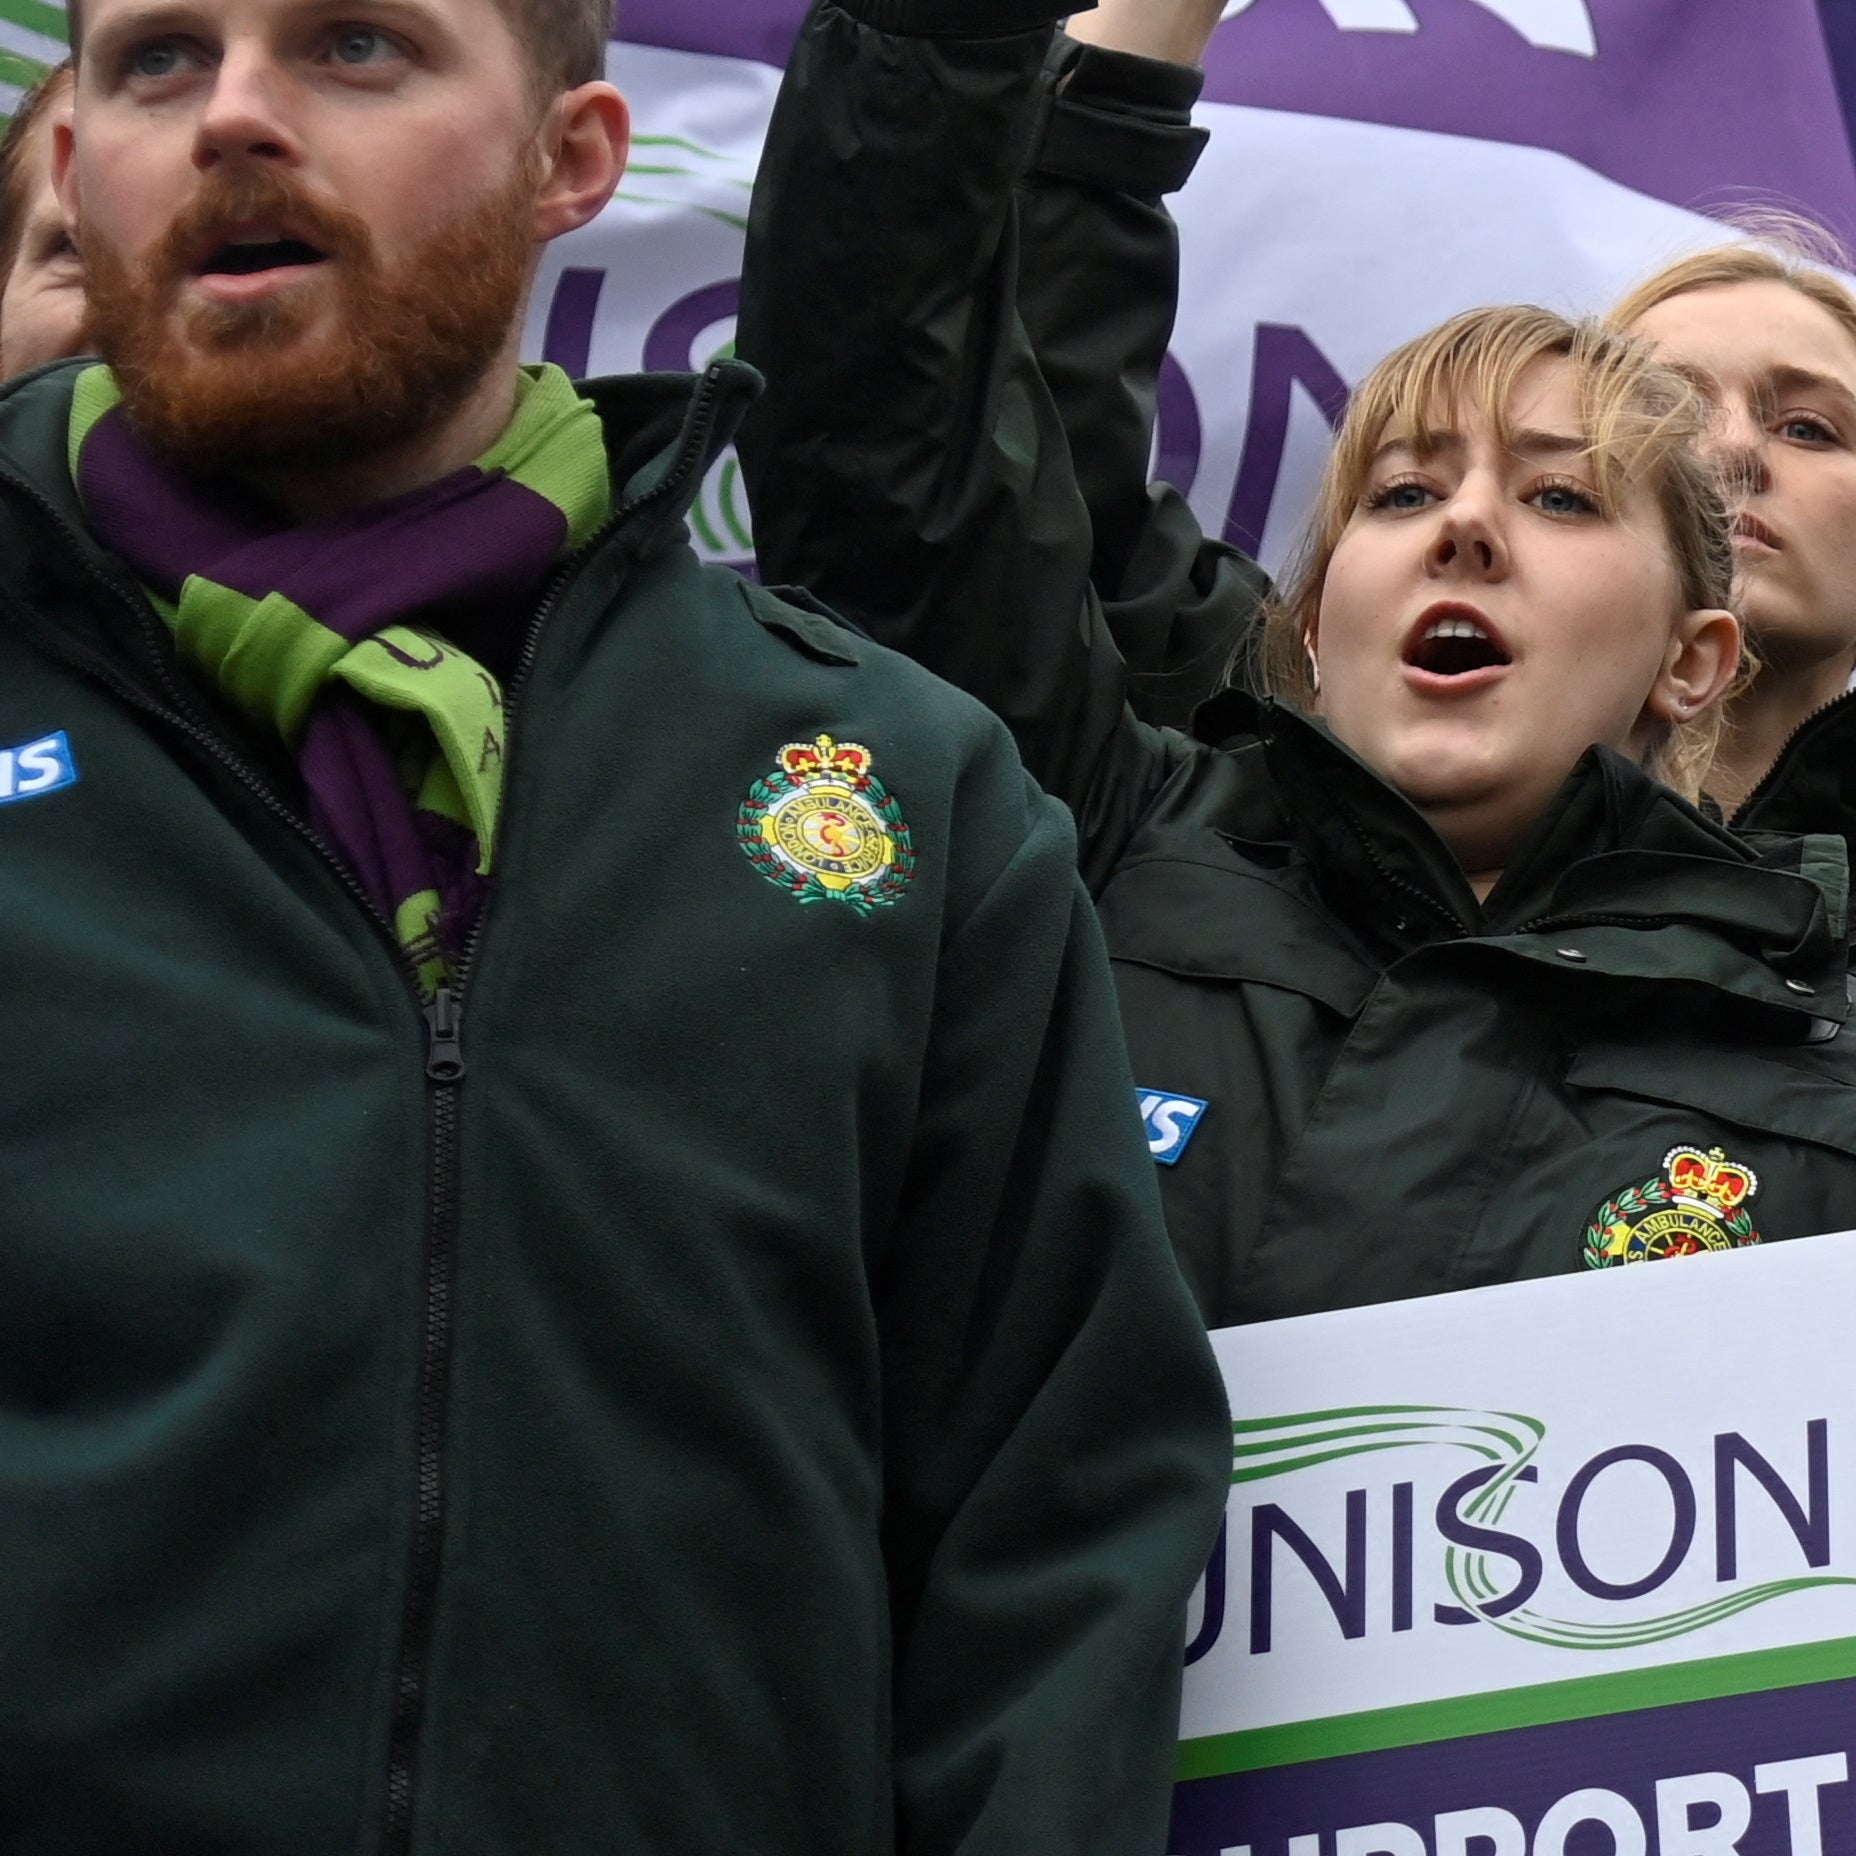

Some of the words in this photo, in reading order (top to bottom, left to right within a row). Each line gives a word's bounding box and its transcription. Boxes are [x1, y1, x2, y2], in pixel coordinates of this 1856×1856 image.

[789, 795, 872, 830] AMBULANCE
[779, 821, 824, 868] LONDON
[1636, 1213, 1727, 1251] AMBULANCE
